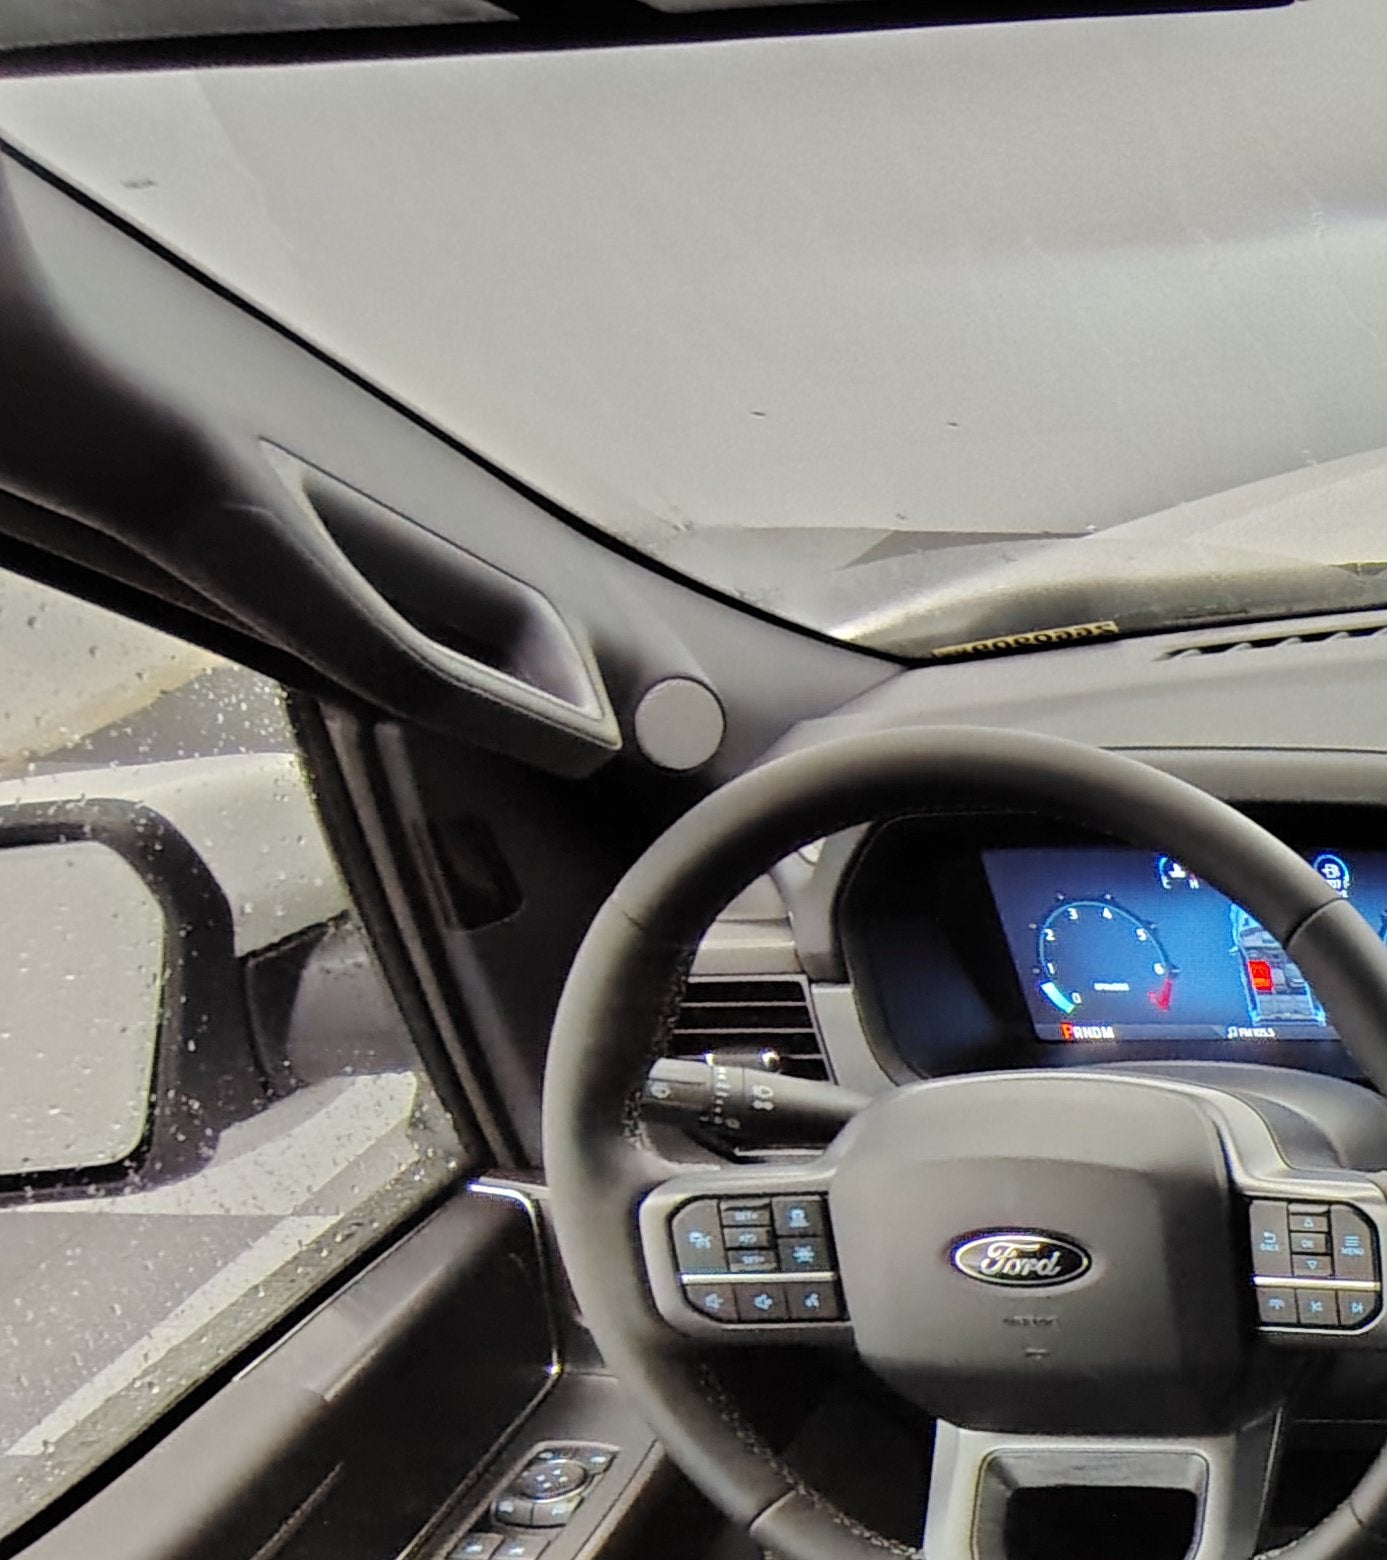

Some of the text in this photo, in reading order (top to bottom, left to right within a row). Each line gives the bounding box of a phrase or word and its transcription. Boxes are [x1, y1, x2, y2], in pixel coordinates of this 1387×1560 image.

[1067, 908, 1078, 920] 3
[1102, 907, 1112, 919] 4
[1044, 928, 1056, 941] 2
[1136, 928, 1148, 941] 5
[1154, 962, 1165, 975] 6
[1071, 992, 1082, 1004] 0
[980, 1241, 1062, 1276] Ford
